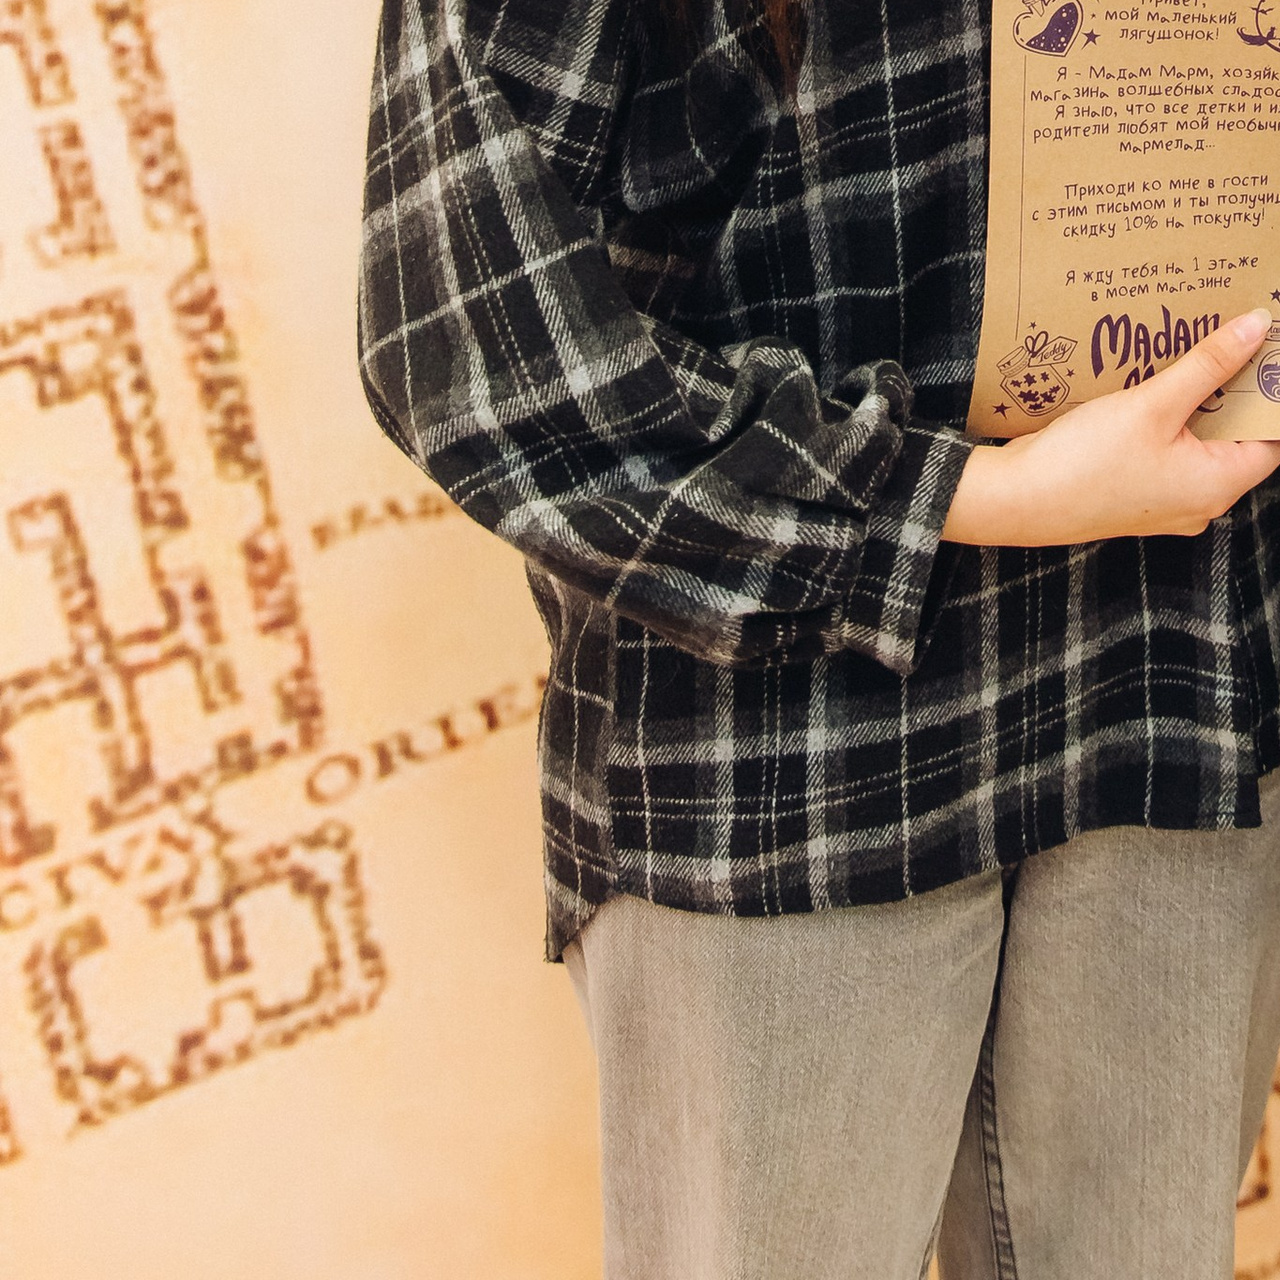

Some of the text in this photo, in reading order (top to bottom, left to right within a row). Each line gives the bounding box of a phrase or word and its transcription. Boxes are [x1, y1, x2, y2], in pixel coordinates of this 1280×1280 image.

[1105, 8, 1237, 24] мой маленький
[1119, 28, 1219, 44] лягушонок!
[1057, 66, 1067, 81] Я
[1090, 66, 1151, 81] Мадам
[1160, 65, 1213, 80] Марм,
[1031, 86, 1109, 102] магазина
[1118, 83, 1214, 97] волшебных
[1056, 104, 1065, 119] Я
[1073, 105, 1117, 118] знаю,
[1126, 103, 1155, 115] что
[1164, 102, 1189, 114] все
[1197, 102, 1245, 115] детки
[1253, 103, 1261, 113] и
[1034, 123, 1109, 143] родители
[1118, 120, 1168, 134] любят
[1176, 117, 1208, 131] мой
[1065, 175, 1268, 201] Приходи ко мне в гости
[1032, 210, 1039, 221] с
[1047, 206, 1087, 221] этим
[1096, 199, 1165, 215] письмом
[1174, 198, 1181, 208] и
[1190, 196, 1209, 207] ты
[1063, 208, 1266, 238] скидку 10% на покупку!
[1066, 256, 1259, 286] Я жду тебя на 1 этаже
[1091, 276, 1231, 302] в моем магазине
[1038, 341, 1072, 363] Teddy
[306, 674, 547, 805] ORIE
